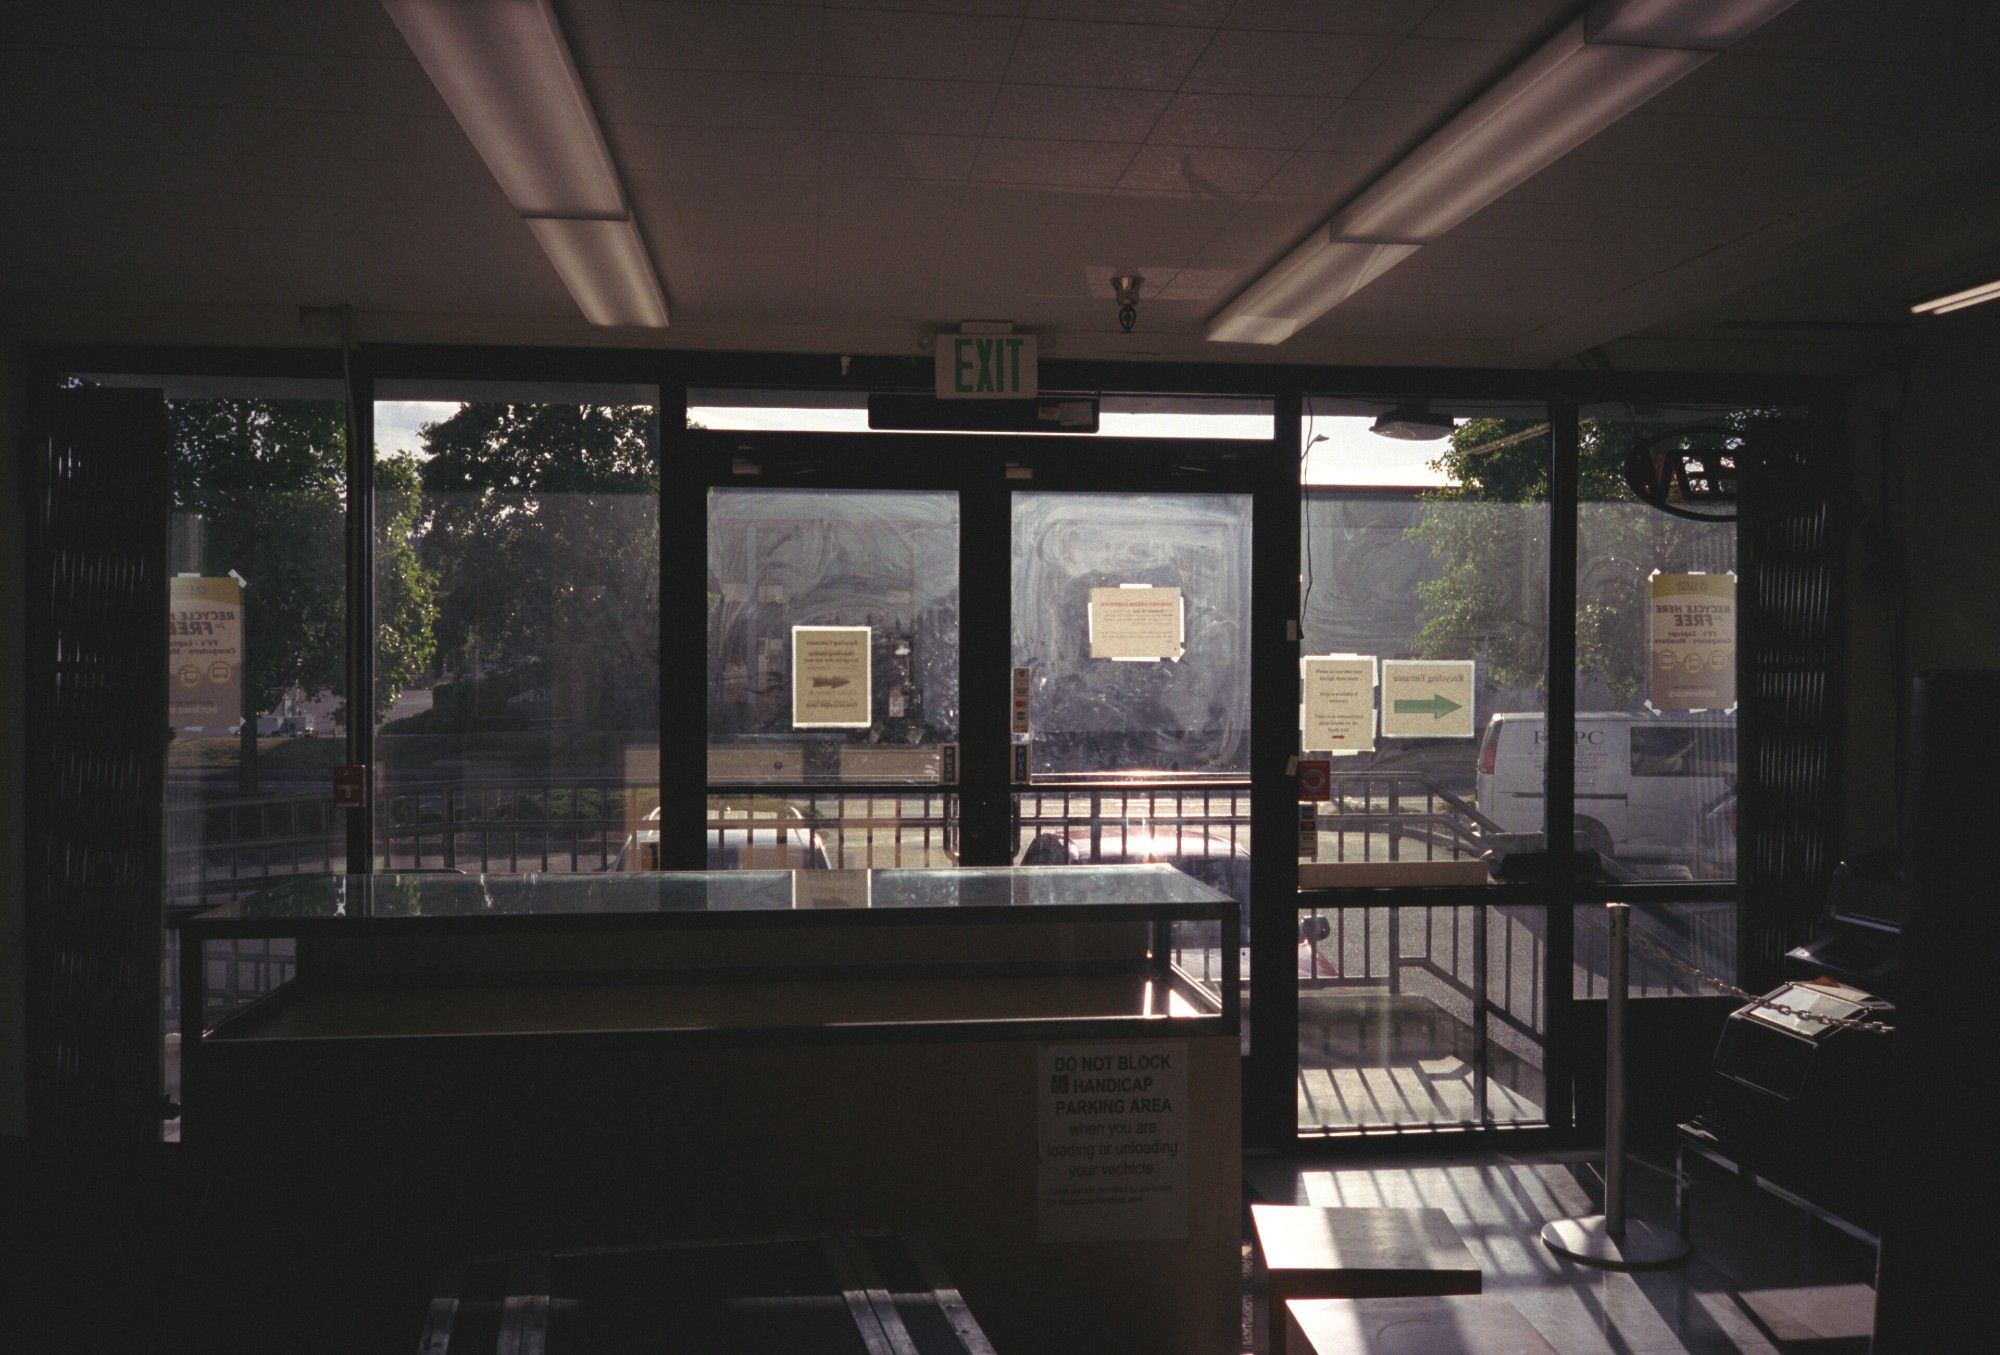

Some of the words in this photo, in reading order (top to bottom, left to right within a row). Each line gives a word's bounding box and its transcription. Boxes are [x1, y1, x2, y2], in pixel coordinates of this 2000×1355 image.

[954, 338, 1024, 393] EXIT
[1055, 1056, 1078, 1072] DO
[1082, 1055, 1113, 1072] NOT
[1118, 1054, 1171, 1071] BLOCK
[1073, 1077, 1153, 1094] HANDICAP
[1056, 1099, 1125, 1115] PARKING
[1129, 1098, 1172, 1114] AREA
[1069, 1122, 1104, 1136] when
[1107, 1123, 1132, 1138] you
[1135, 1122, 1157, 1135] are
[1047, 1143, 1094, 1160] loading
[1098, 1144, 1112, 1156] or
[1115, 1140, 1179, 1157] unloading
[1068, 1165, 1098, 1180] your
